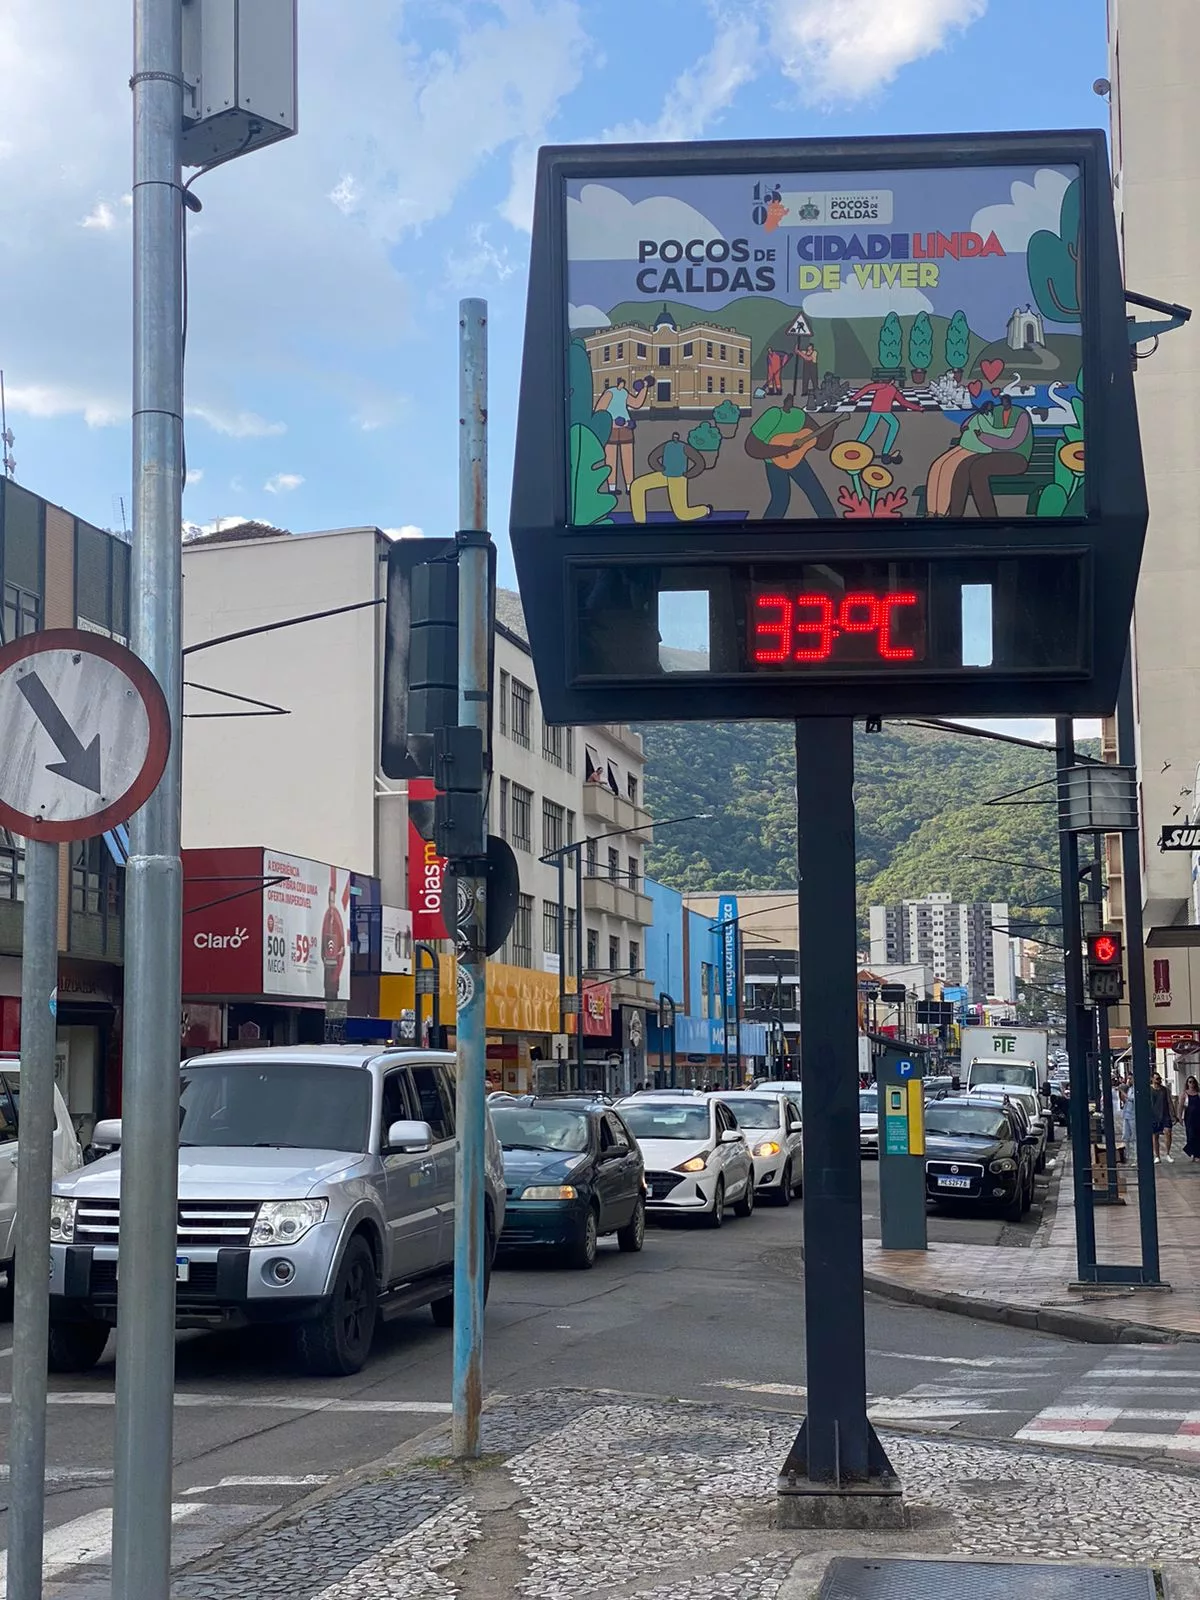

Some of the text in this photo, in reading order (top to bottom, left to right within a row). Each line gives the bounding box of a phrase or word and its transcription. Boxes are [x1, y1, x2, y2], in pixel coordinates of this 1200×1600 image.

[830, 209, 878, 220] CALDAS
[831, 200, 870, 211] POÇOS
[638, 238, 776, 266] POÇOS DE
[796, 230, 1007, 261] CIDADE LINDA
[636, 266, 776, 293] CALDAS
[799, 261, 940, 290] DE VIVER
[193, 931, 243, 949] Claro
[268, 935, 286, 958] 500
[268, 958, 286, 974] MEGA
[992, 1035, 1017, 1054] PTE
[900, 1061, 911, 1075] P
